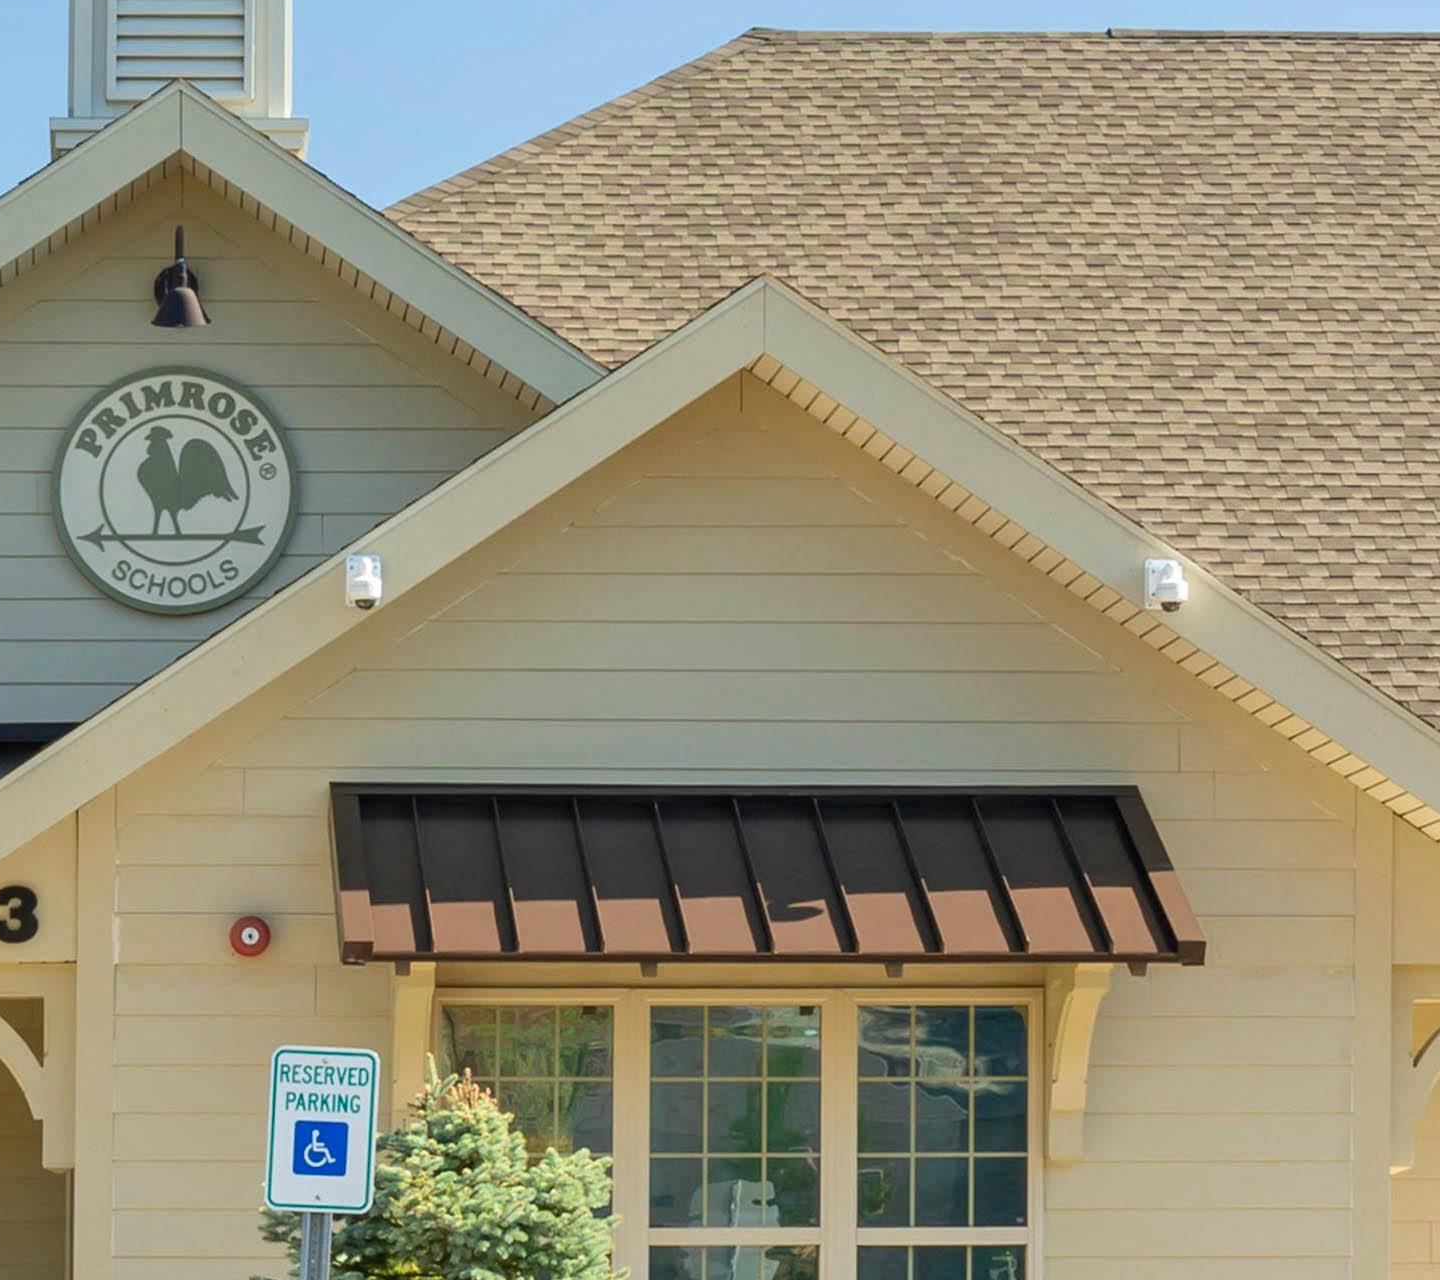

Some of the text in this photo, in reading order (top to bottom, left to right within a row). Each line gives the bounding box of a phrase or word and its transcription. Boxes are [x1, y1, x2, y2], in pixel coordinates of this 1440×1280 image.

[75, 380, 277, 462] PRIMROSE
[111, 559, 240, 599] SCHOOLS
[279, 1064, 369, 1087] RESERVED
[285, 1091, 361, 1114] PARKING
